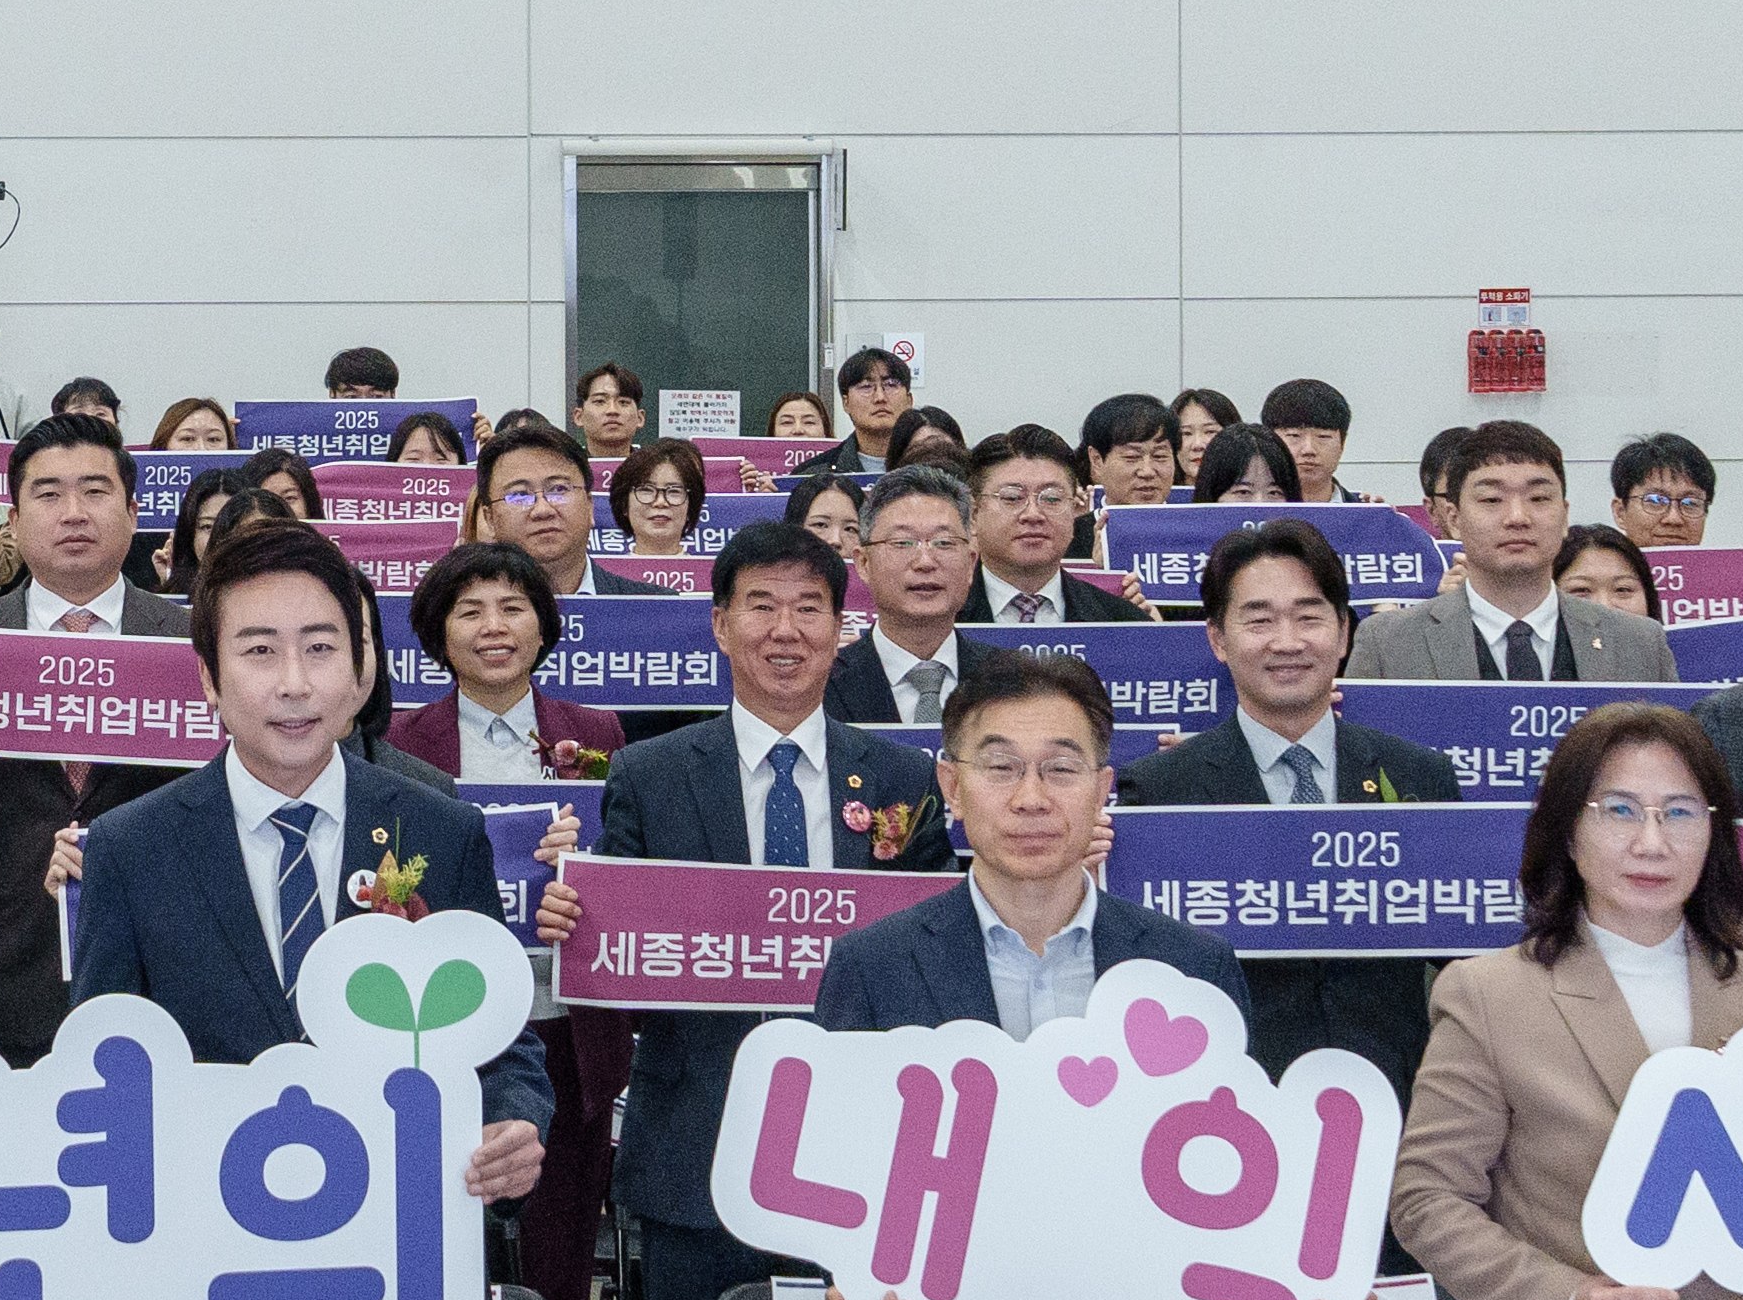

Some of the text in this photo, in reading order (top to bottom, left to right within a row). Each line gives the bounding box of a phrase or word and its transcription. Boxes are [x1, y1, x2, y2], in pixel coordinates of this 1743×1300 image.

[335, 411, 380, 430] 2025
[252, 434, 392, 458] 세종청년취업
[144, 465, 193, 488] 2025
[402, 477, 451, 498] 2025
[38, 655, 116, 687] 2025
[1311, 830, 1401, 869] 2025
[767, 887, 857, 925] 2025
[1142, 877, 1524, 928] 세종청년취업박람
